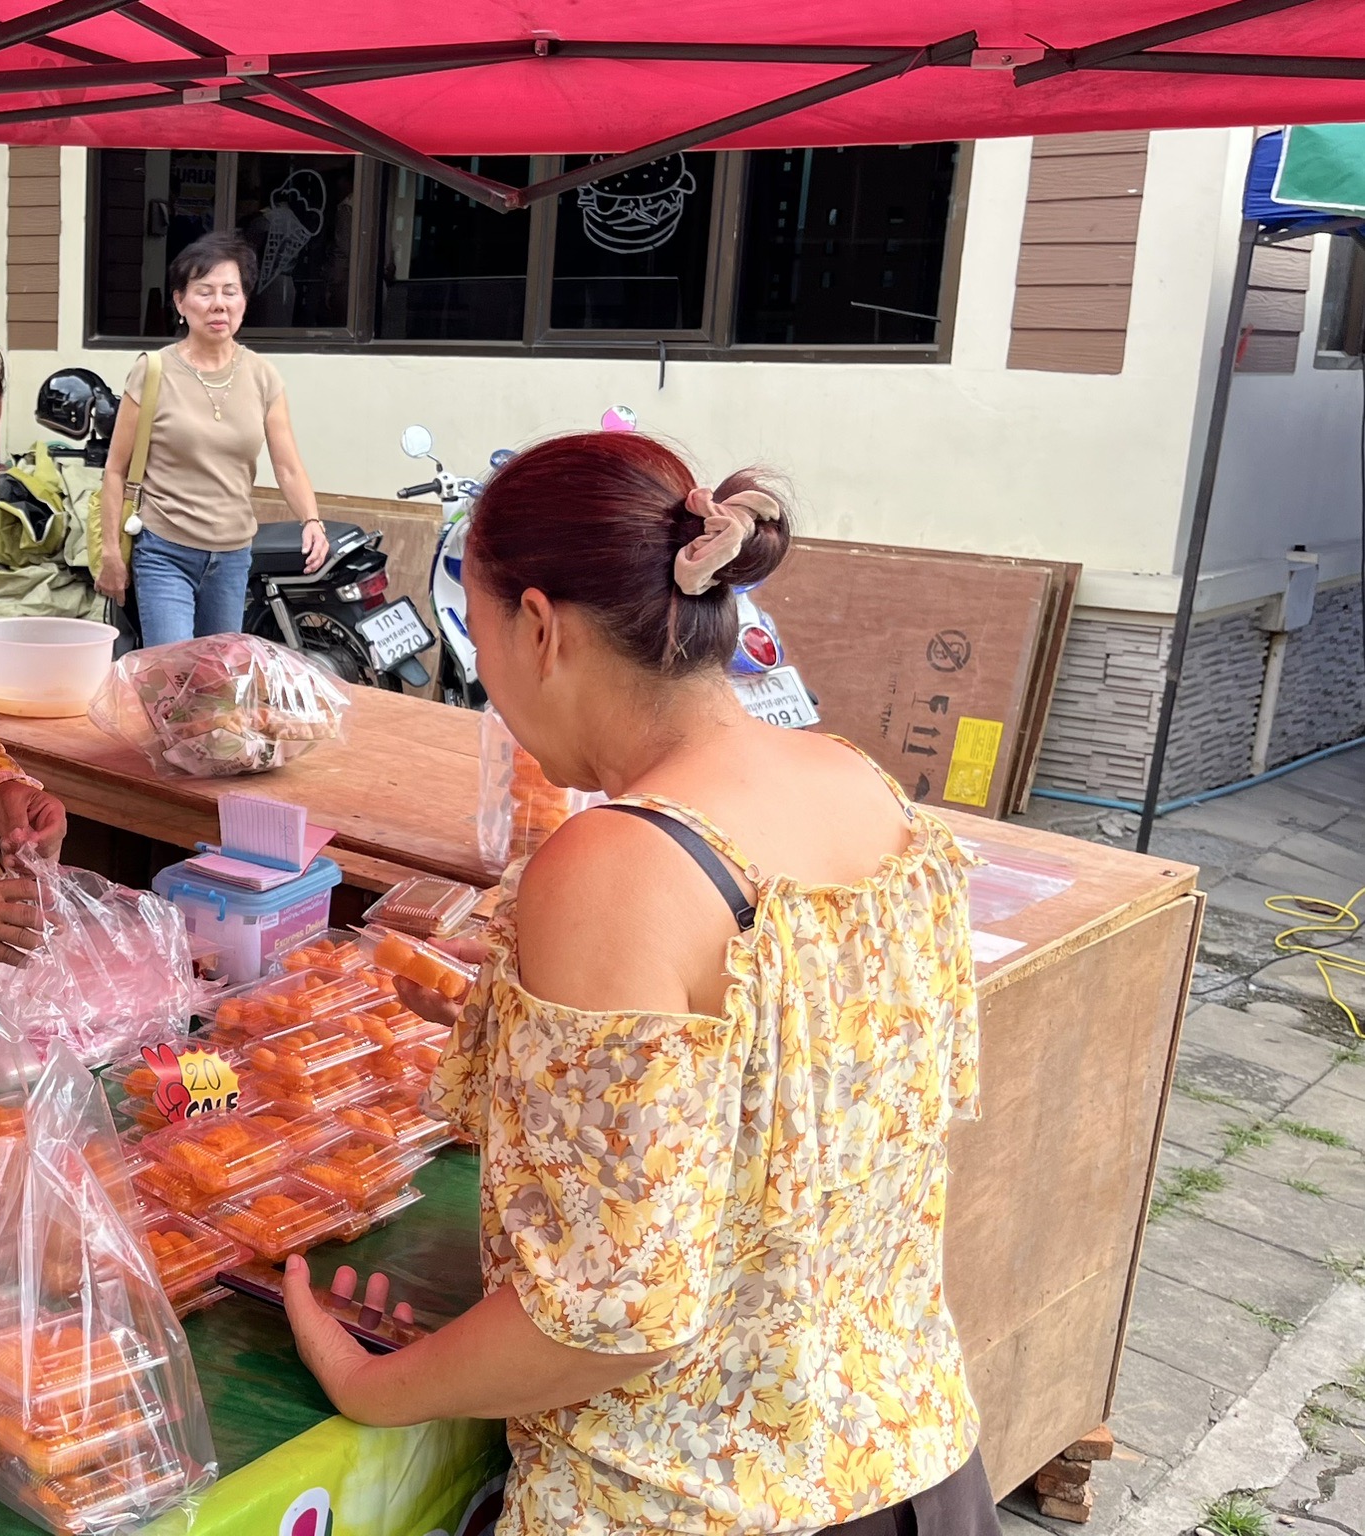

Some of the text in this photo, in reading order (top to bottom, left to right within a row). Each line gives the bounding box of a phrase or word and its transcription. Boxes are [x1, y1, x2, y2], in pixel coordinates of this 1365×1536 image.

[374, 608, 403, 632] 1กง
[387, 634, 423, 661] 2270
[755, 707, 803, 726] 091
[184, 1058, 222, 1092] 20
